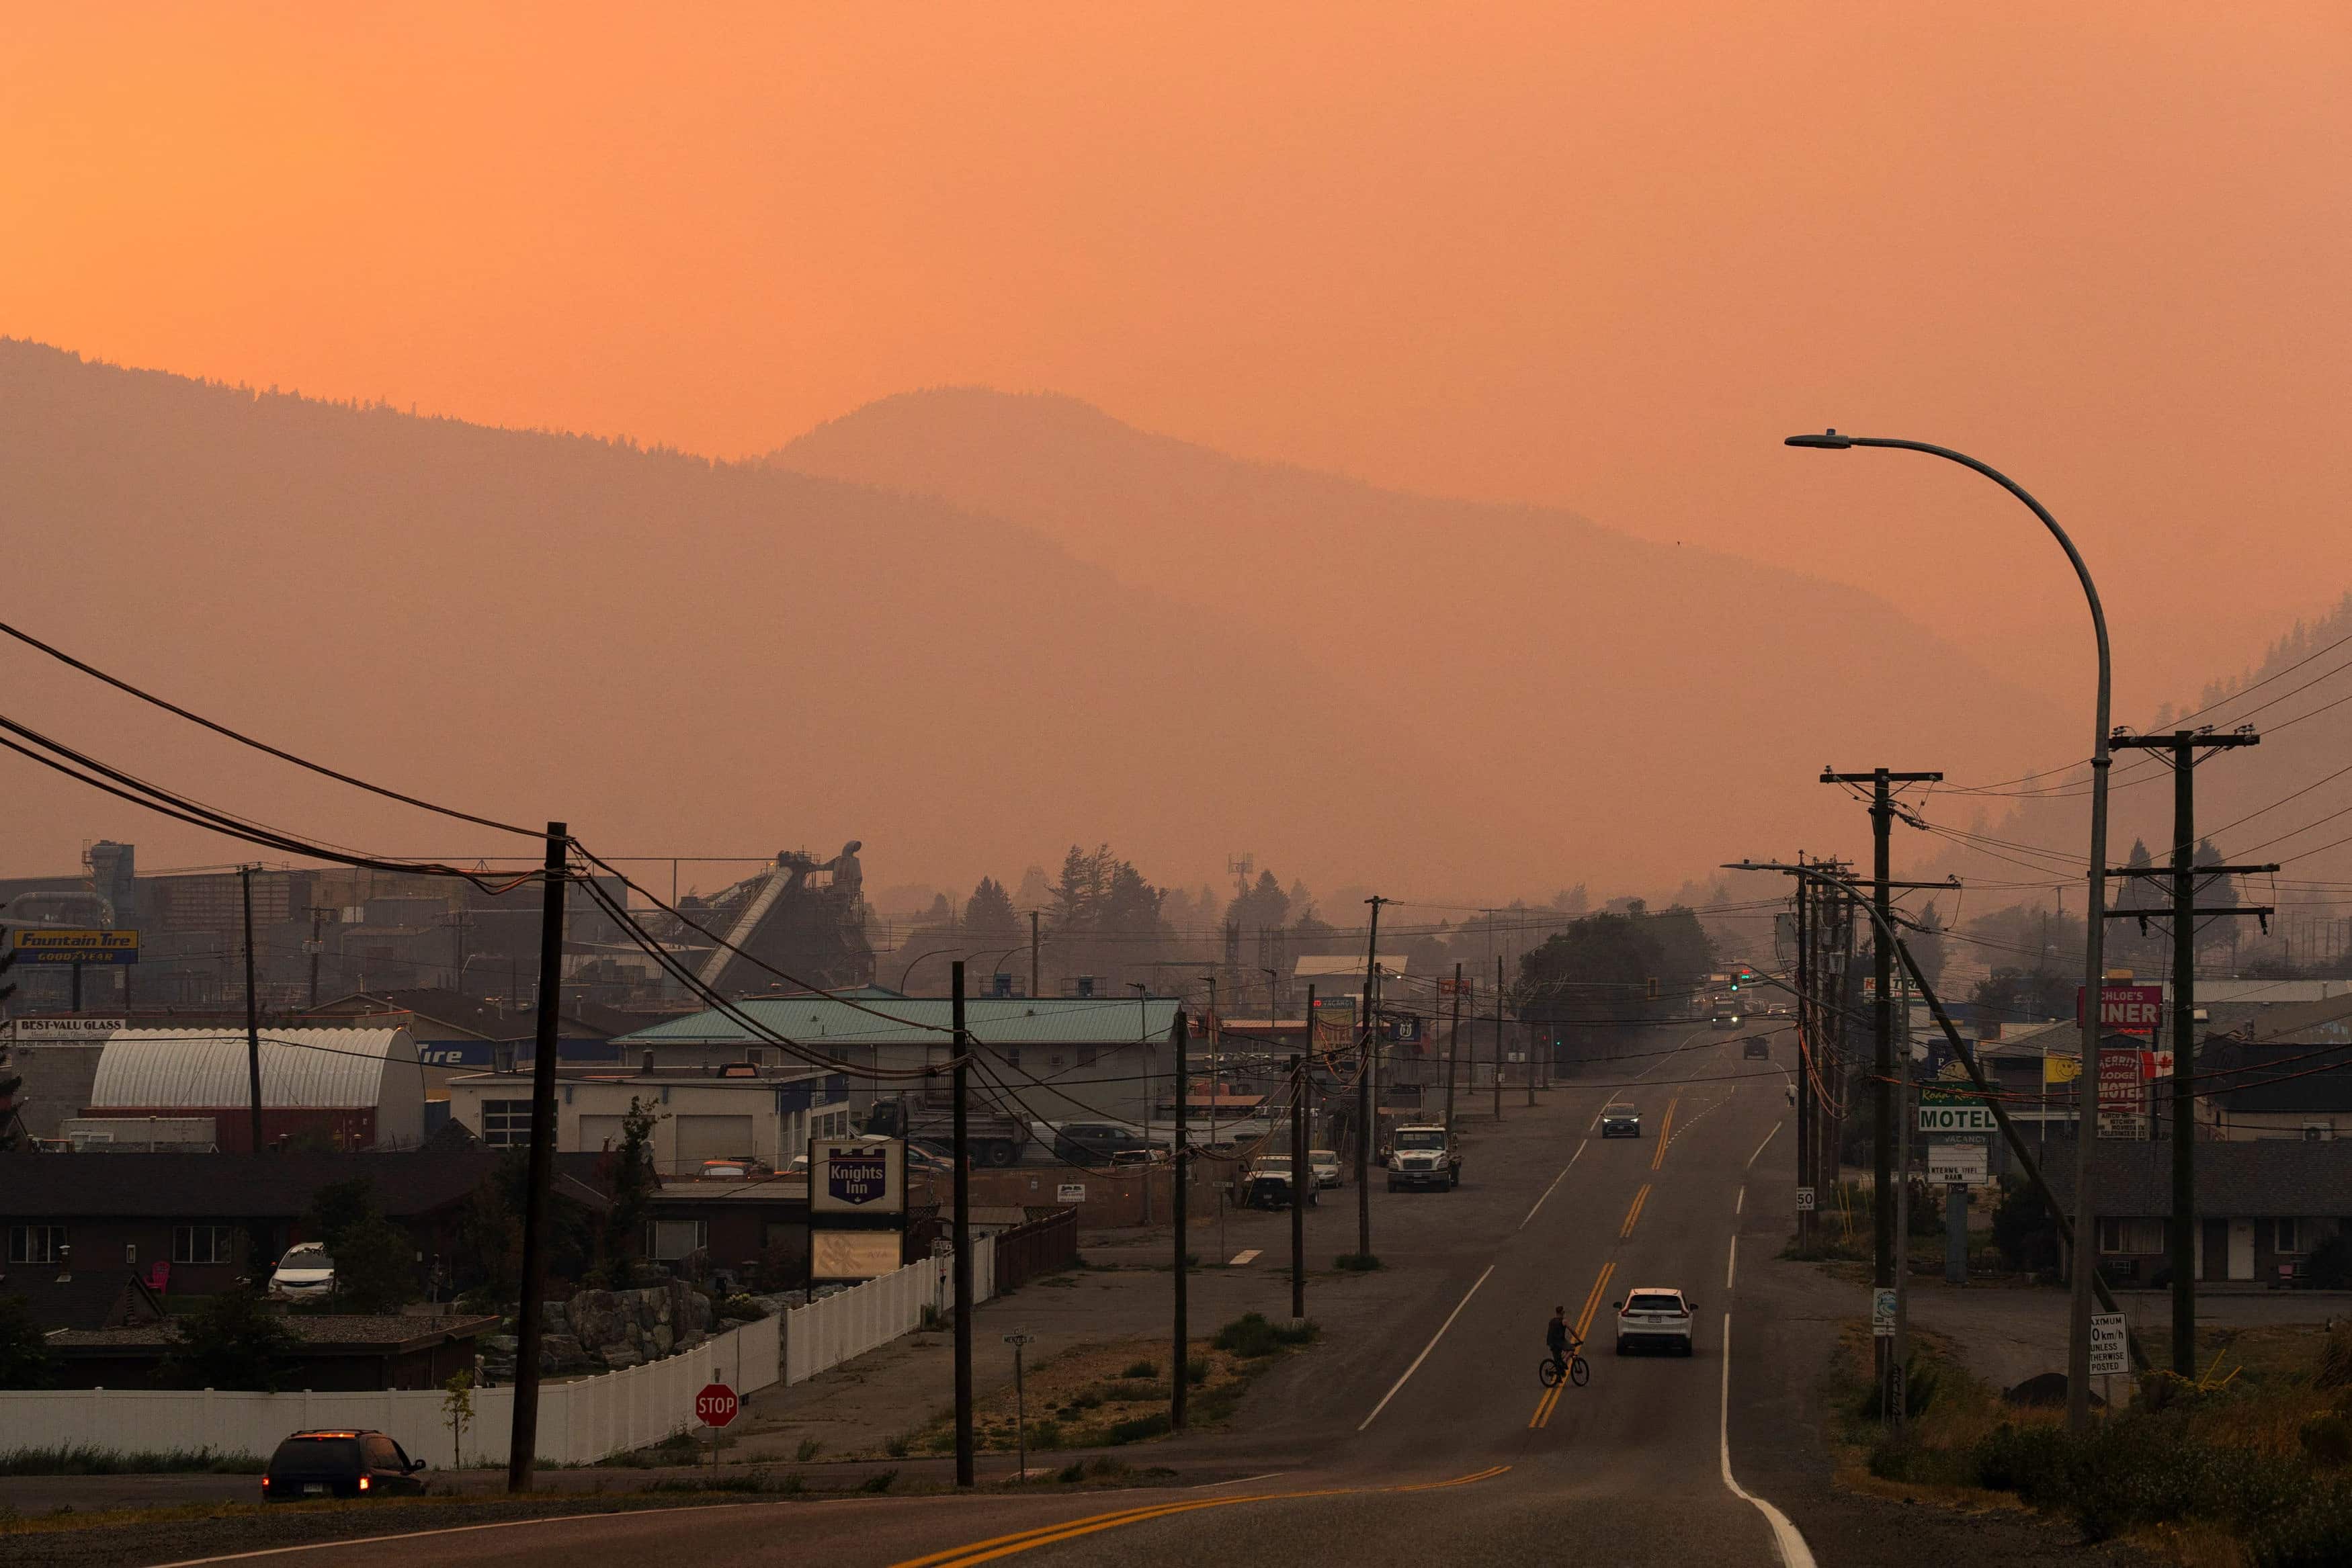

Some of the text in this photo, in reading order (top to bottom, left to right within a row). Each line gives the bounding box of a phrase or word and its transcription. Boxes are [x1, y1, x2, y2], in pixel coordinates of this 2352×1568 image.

[22, 932, 130, 946] Fountain Tire
[38, 951, 113, 962] GOODYEAR
[2101, 1004, 2157, 1022] INER
[22, 1020, 122, 1030] BEST-VALU GLASS
[416, 1043, 463, 1063] Tire
[2101, 1072, 2136, 1080] LODGE
[1921, 1110, 1996, 1128] MOTEL
[1945, 1135, 1986, 1143] VACANCY
[831, 1165, 883, 1182] Knights
[846, 1180, 868, 1194] Inn
[1798, 1194, 1812, 1204] 50
[2091, 1317, 2122, 1325] AXIMUM
[2092, 1328, 2124, 1341] 0 km/h
[2091, 1343, 2118, 1352] UNLESS
[2091, 1352, 2125, 1362] THERWISE
[2091, 1362, 2119, 1371] POSTED
[698, 1397, 734, 1414] STOP
